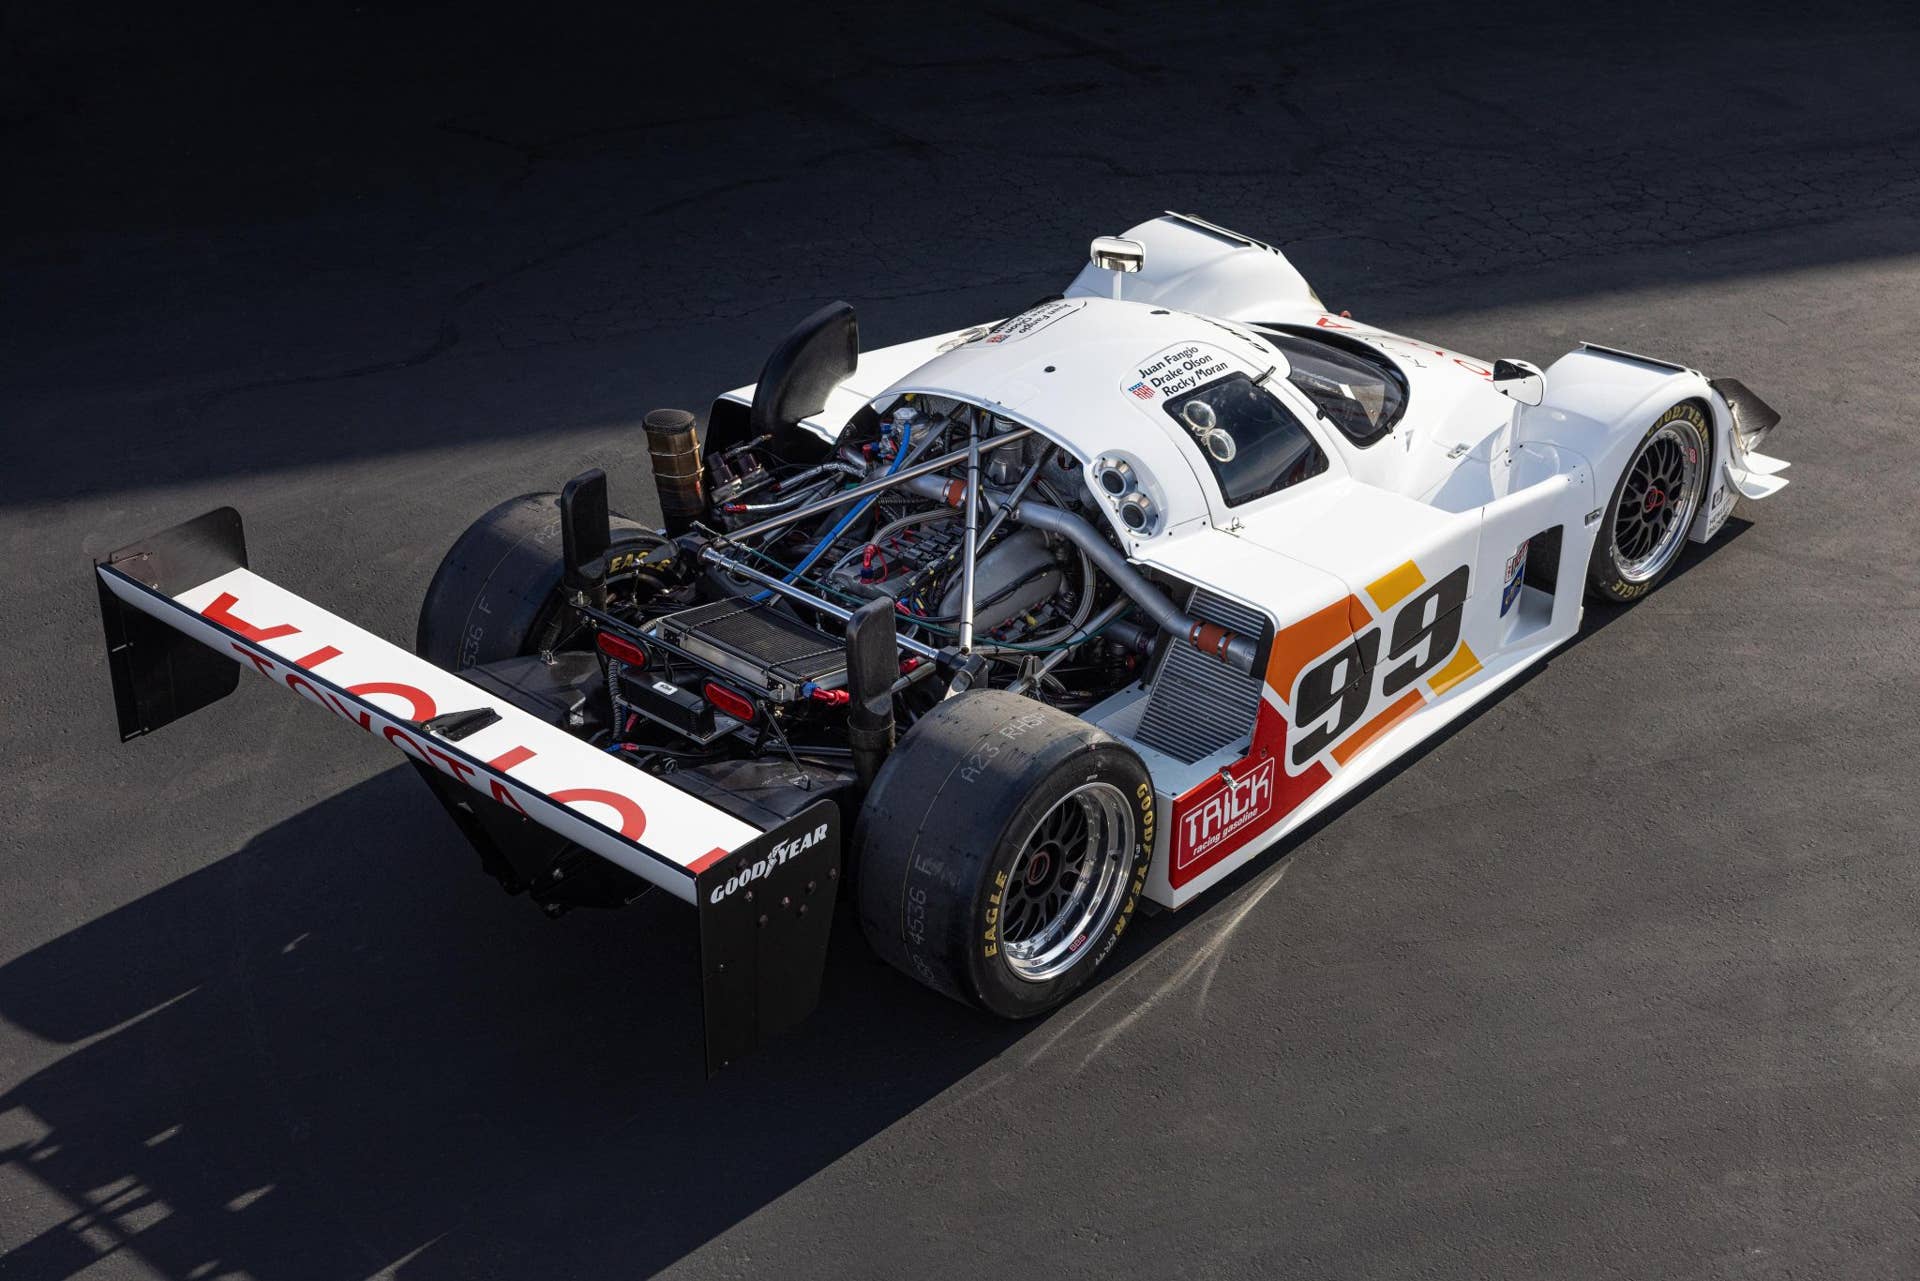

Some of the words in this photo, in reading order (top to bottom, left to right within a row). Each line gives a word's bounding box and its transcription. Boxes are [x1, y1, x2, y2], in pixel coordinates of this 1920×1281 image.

[1138, 361, 1166, 379] Juan
[1164, 346, 1199, 365] Fangio
[1150, 369, 1184, 388] Drake
[1183, 354, 1213, 371] Olson
[1161, 378, 1196, 397] Rocky
[1195, 361, 1229, 380] Moran
[1292, 564, 1471, 766] 99
[960, 743, 1000, 783] A23
[1185, 766, 1270, 848] TRICK
[1192, 831, 1221, 856] racing
[1222, 808, 1259, 838] gasoline
[710, 823, 829, 904] GOODYEAR
[1112, 782, 1154, 936] GOODYEAR
[984, 870, 1009, 958] EAGLE
